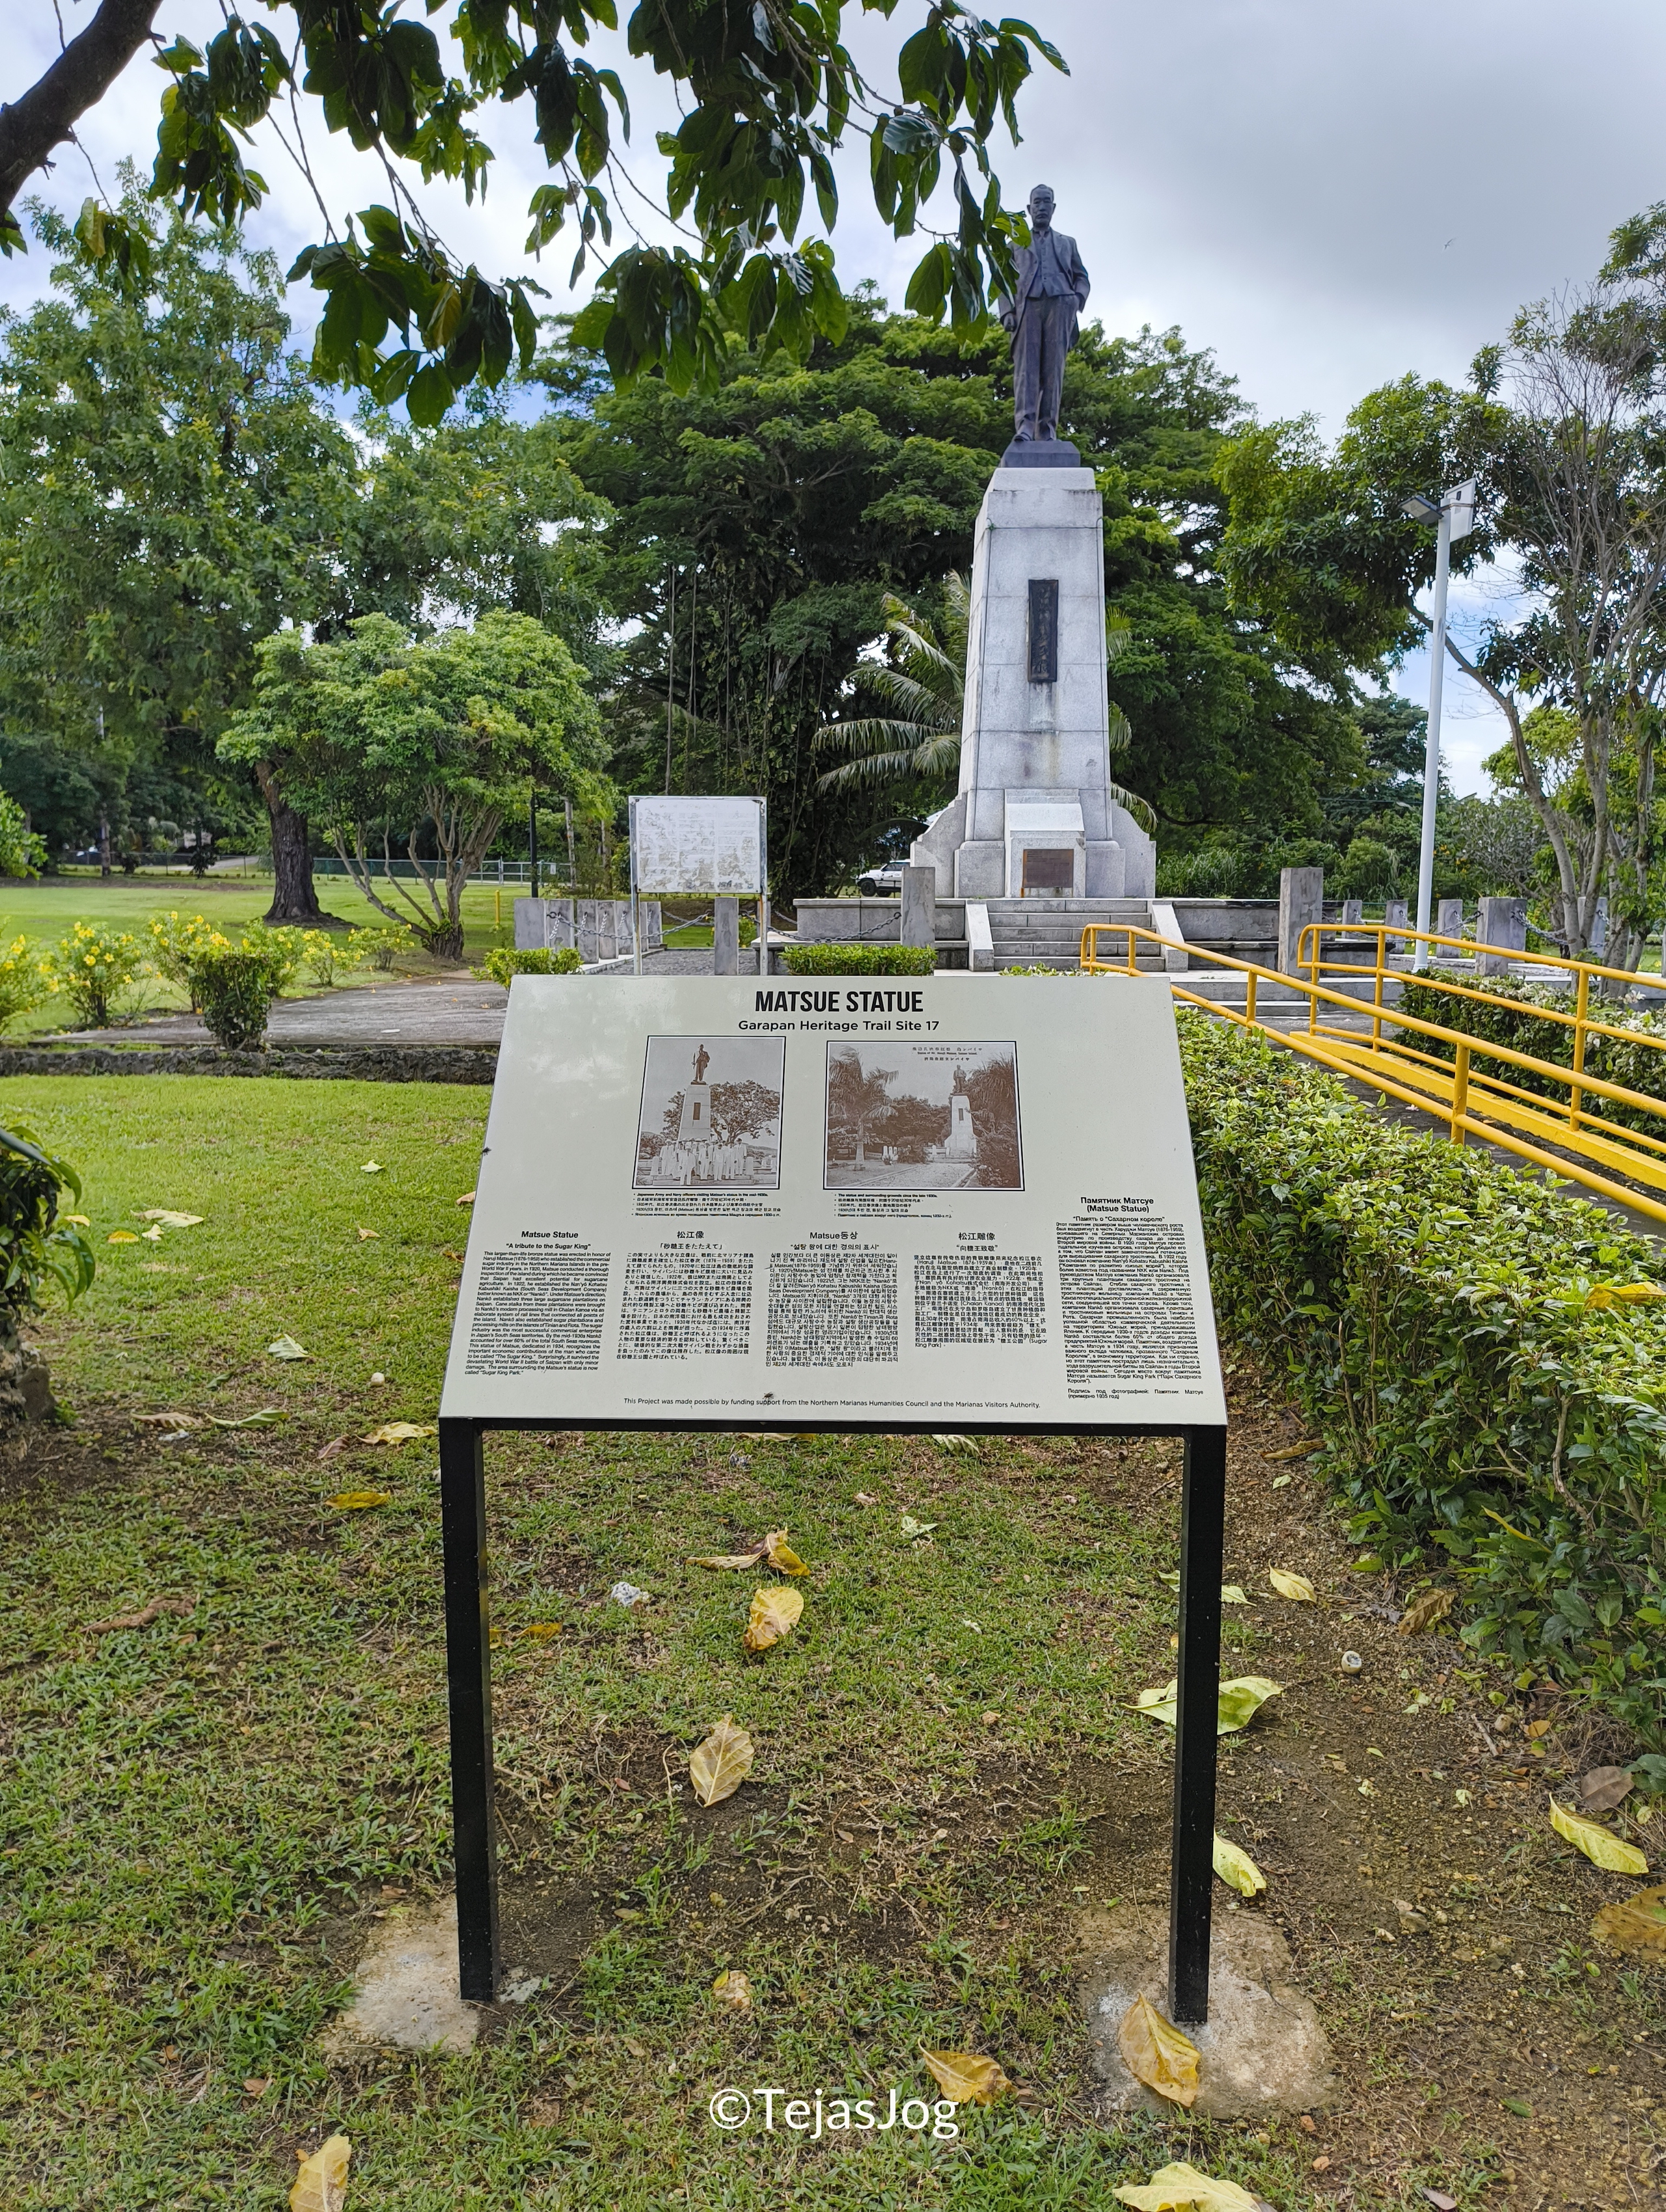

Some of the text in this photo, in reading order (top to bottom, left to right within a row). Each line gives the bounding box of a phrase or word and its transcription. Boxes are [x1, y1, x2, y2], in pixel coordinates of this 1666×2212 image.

[755, 991, 923, 1012] MATSUE STATUE
[738, 1020, 939, 1032] Garapan Heritage Trail Site 17
[677, 1230, 703, 1239] 松江像
[810, 1231, 858, 1239] Matsue동상
[958, 1232, 995, 1241] 松江雕像
